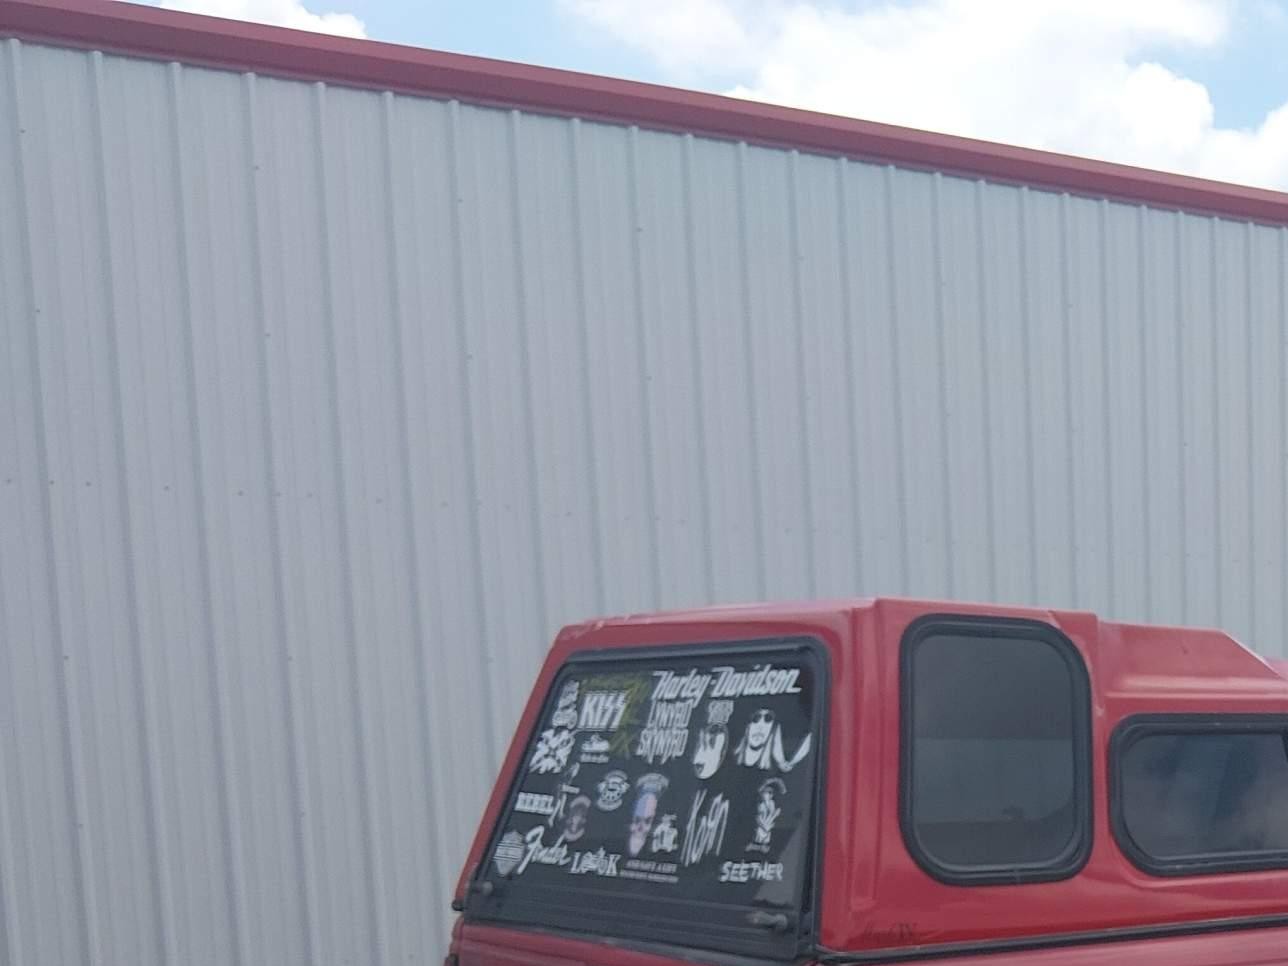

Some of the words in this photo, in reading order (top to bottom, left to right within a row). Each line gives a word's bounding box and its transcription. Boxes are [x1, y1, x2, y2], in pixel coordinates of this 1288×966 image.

[650, 664, 802, 708] Harley-Davidson
[577, 691, 628, 732] KISS
[720, 859, 785, 883] SEETHER
